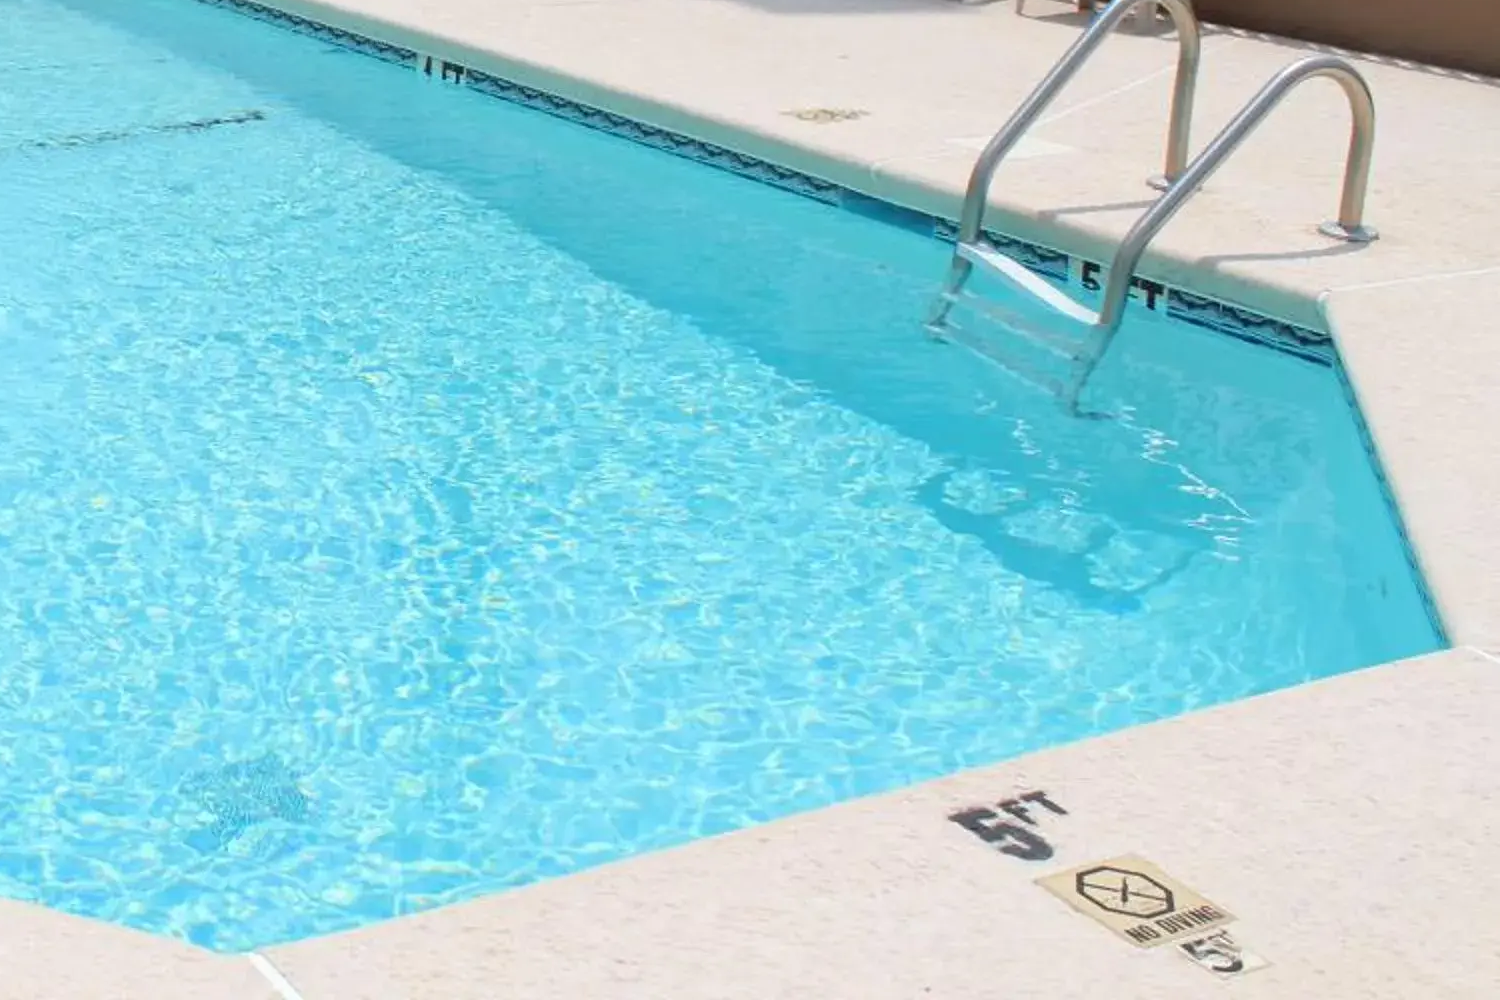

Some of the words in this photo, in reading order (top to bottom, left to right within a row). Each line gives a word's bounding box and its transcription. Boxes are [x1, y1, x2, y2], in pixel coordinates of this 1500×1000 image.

[1081, 260, 1101, 290] 5
[997, 790, 1068, 826] FT
[948, 807, 1054, 860] 5
[1124, 925, 1160, 944] NO
[1155, 904, 1224, 935] DIVING
